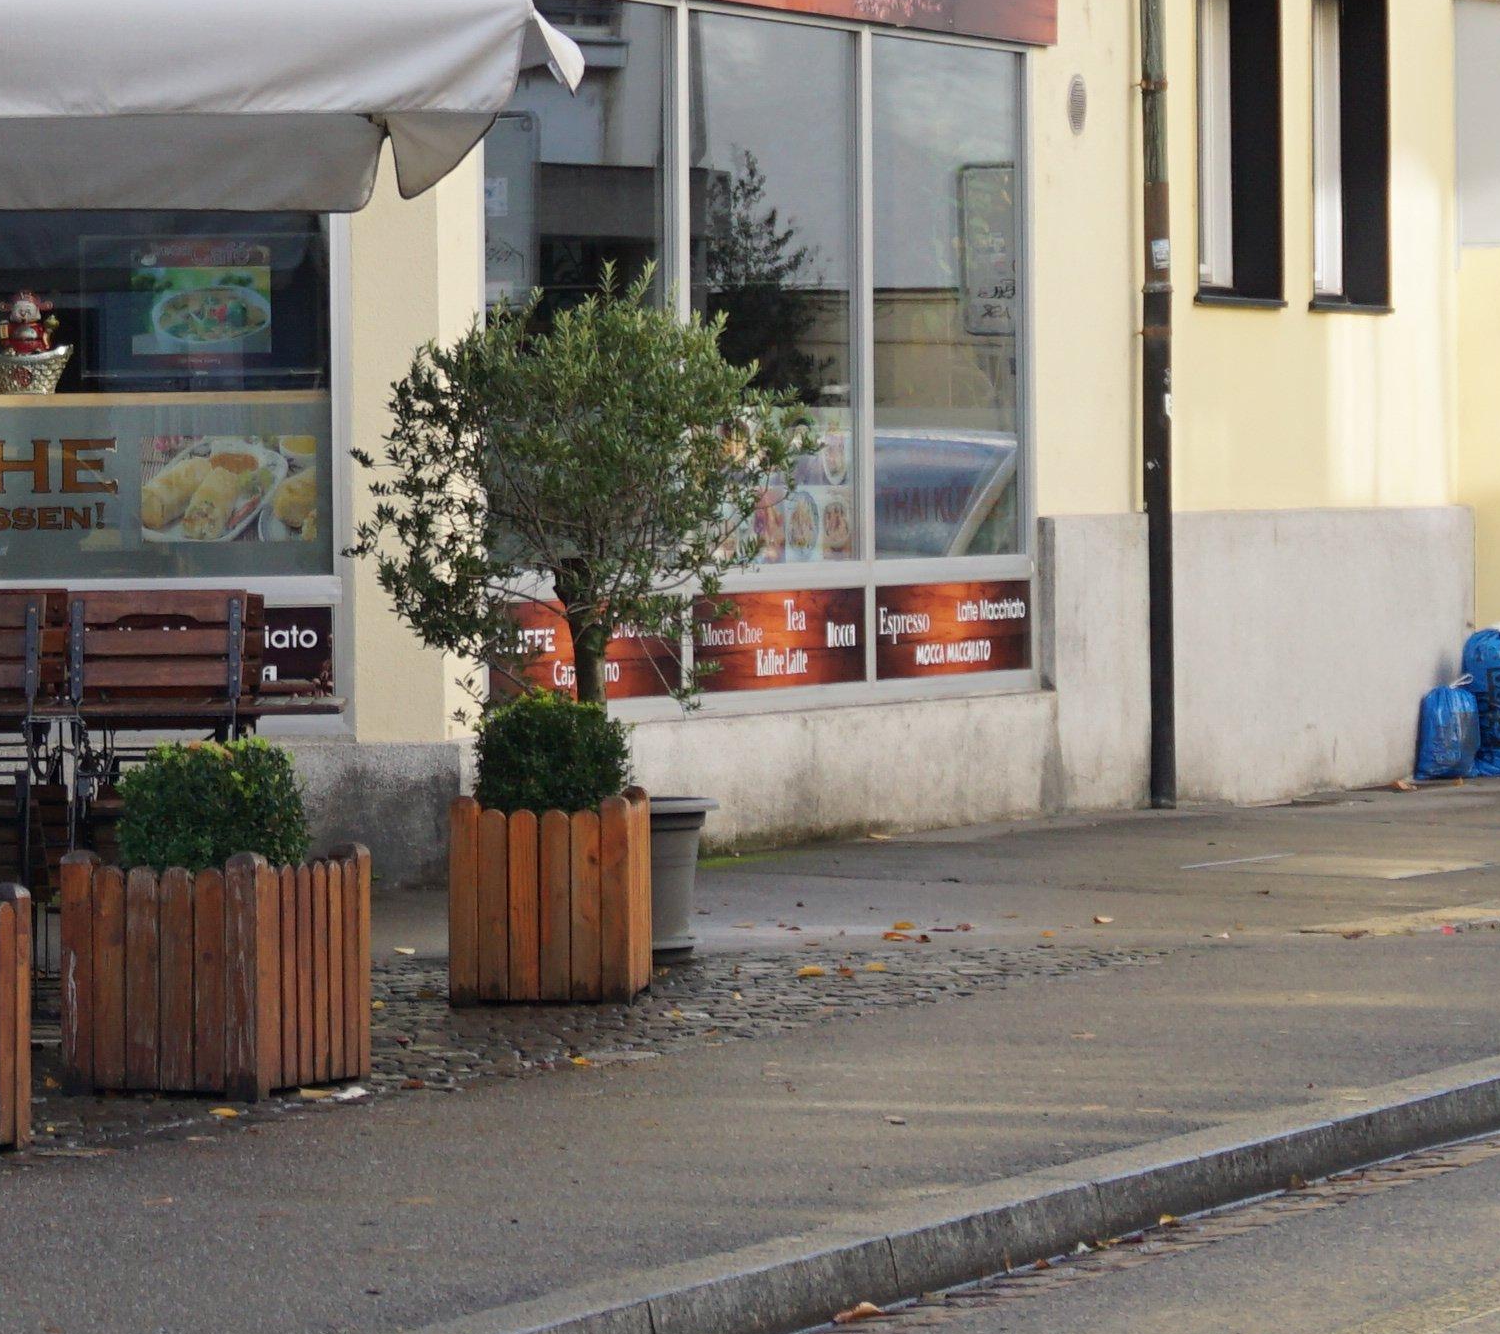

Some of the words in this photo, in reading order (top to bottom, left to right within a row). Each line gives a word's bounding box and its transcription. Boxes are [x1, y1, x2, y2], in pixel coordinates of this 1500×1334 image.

[784, 598, 807, 633] Tea
[979, 596, 1026, 622] Macchiato
[701, 622, 736, 648] Mocca
[879, 607, 931, 645] Espresso
[756, 648, 785, 677] Kaffee
[786, 645, 808, 675] Latte
[915, 643, 946, 666] MOCCA
